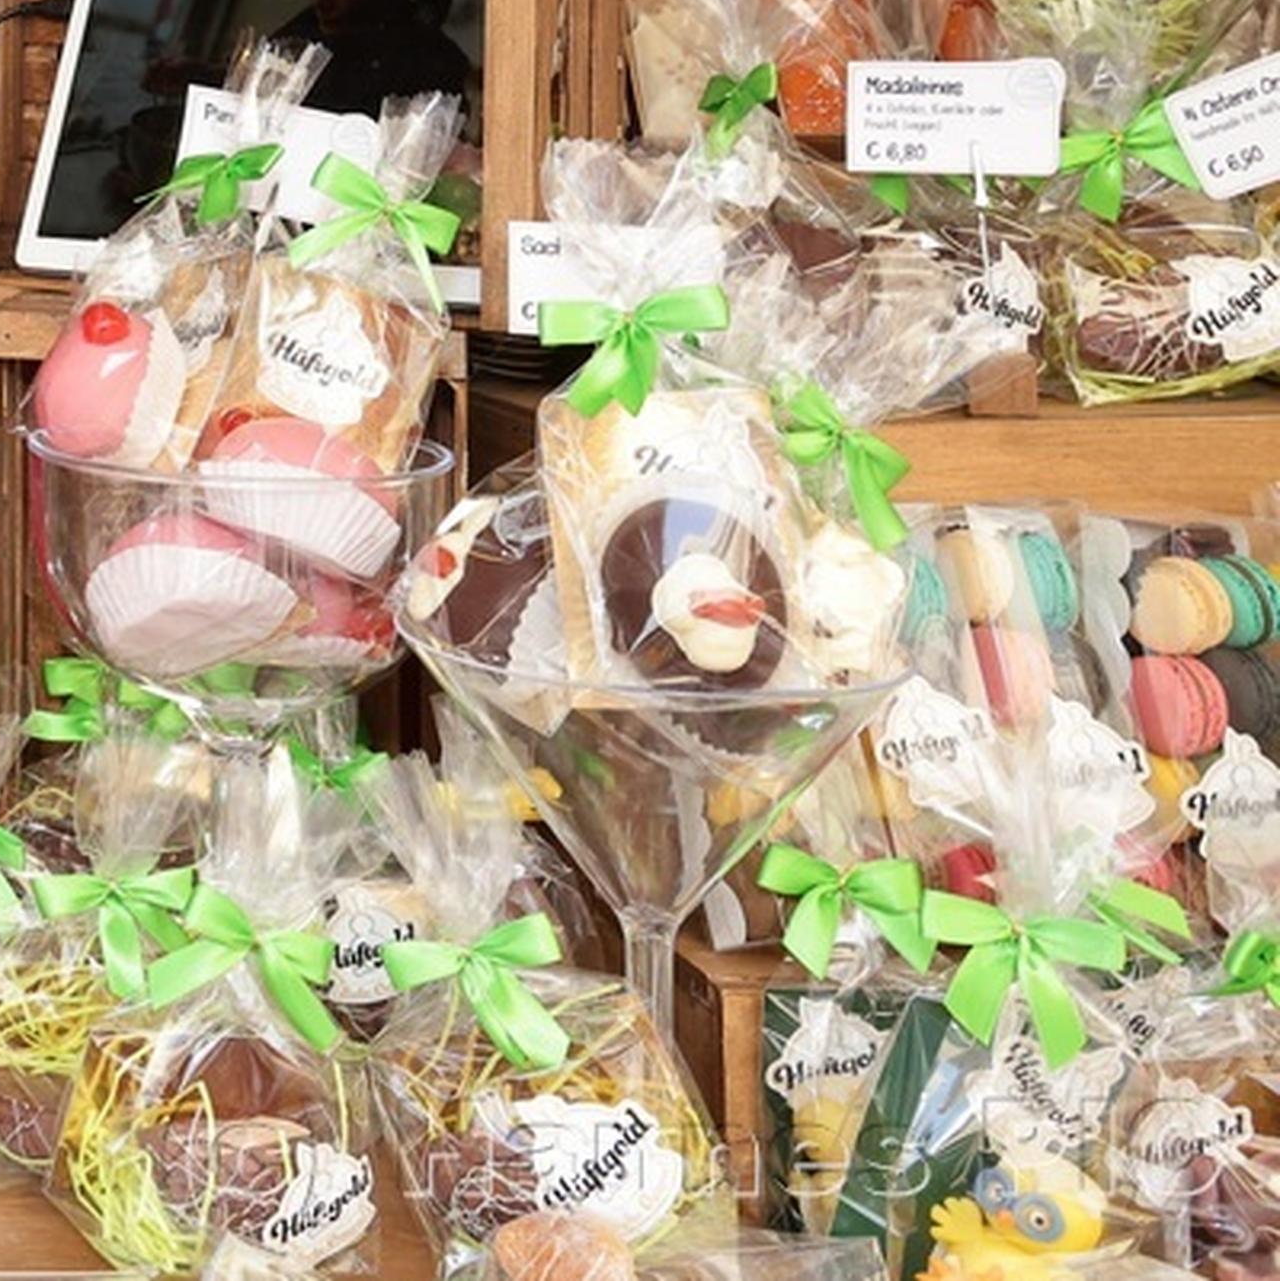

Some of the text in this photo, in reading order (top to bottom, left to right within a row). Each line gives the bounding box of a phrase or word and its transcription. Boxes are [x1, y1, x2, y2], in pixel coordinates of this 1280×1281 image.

[866, 141, 928, 164] € 6,80
[1208, 157, 1225, 178] €
[265, 329, 388, 397] Hüftgold
[333, 922, 416, 971] üftgld
